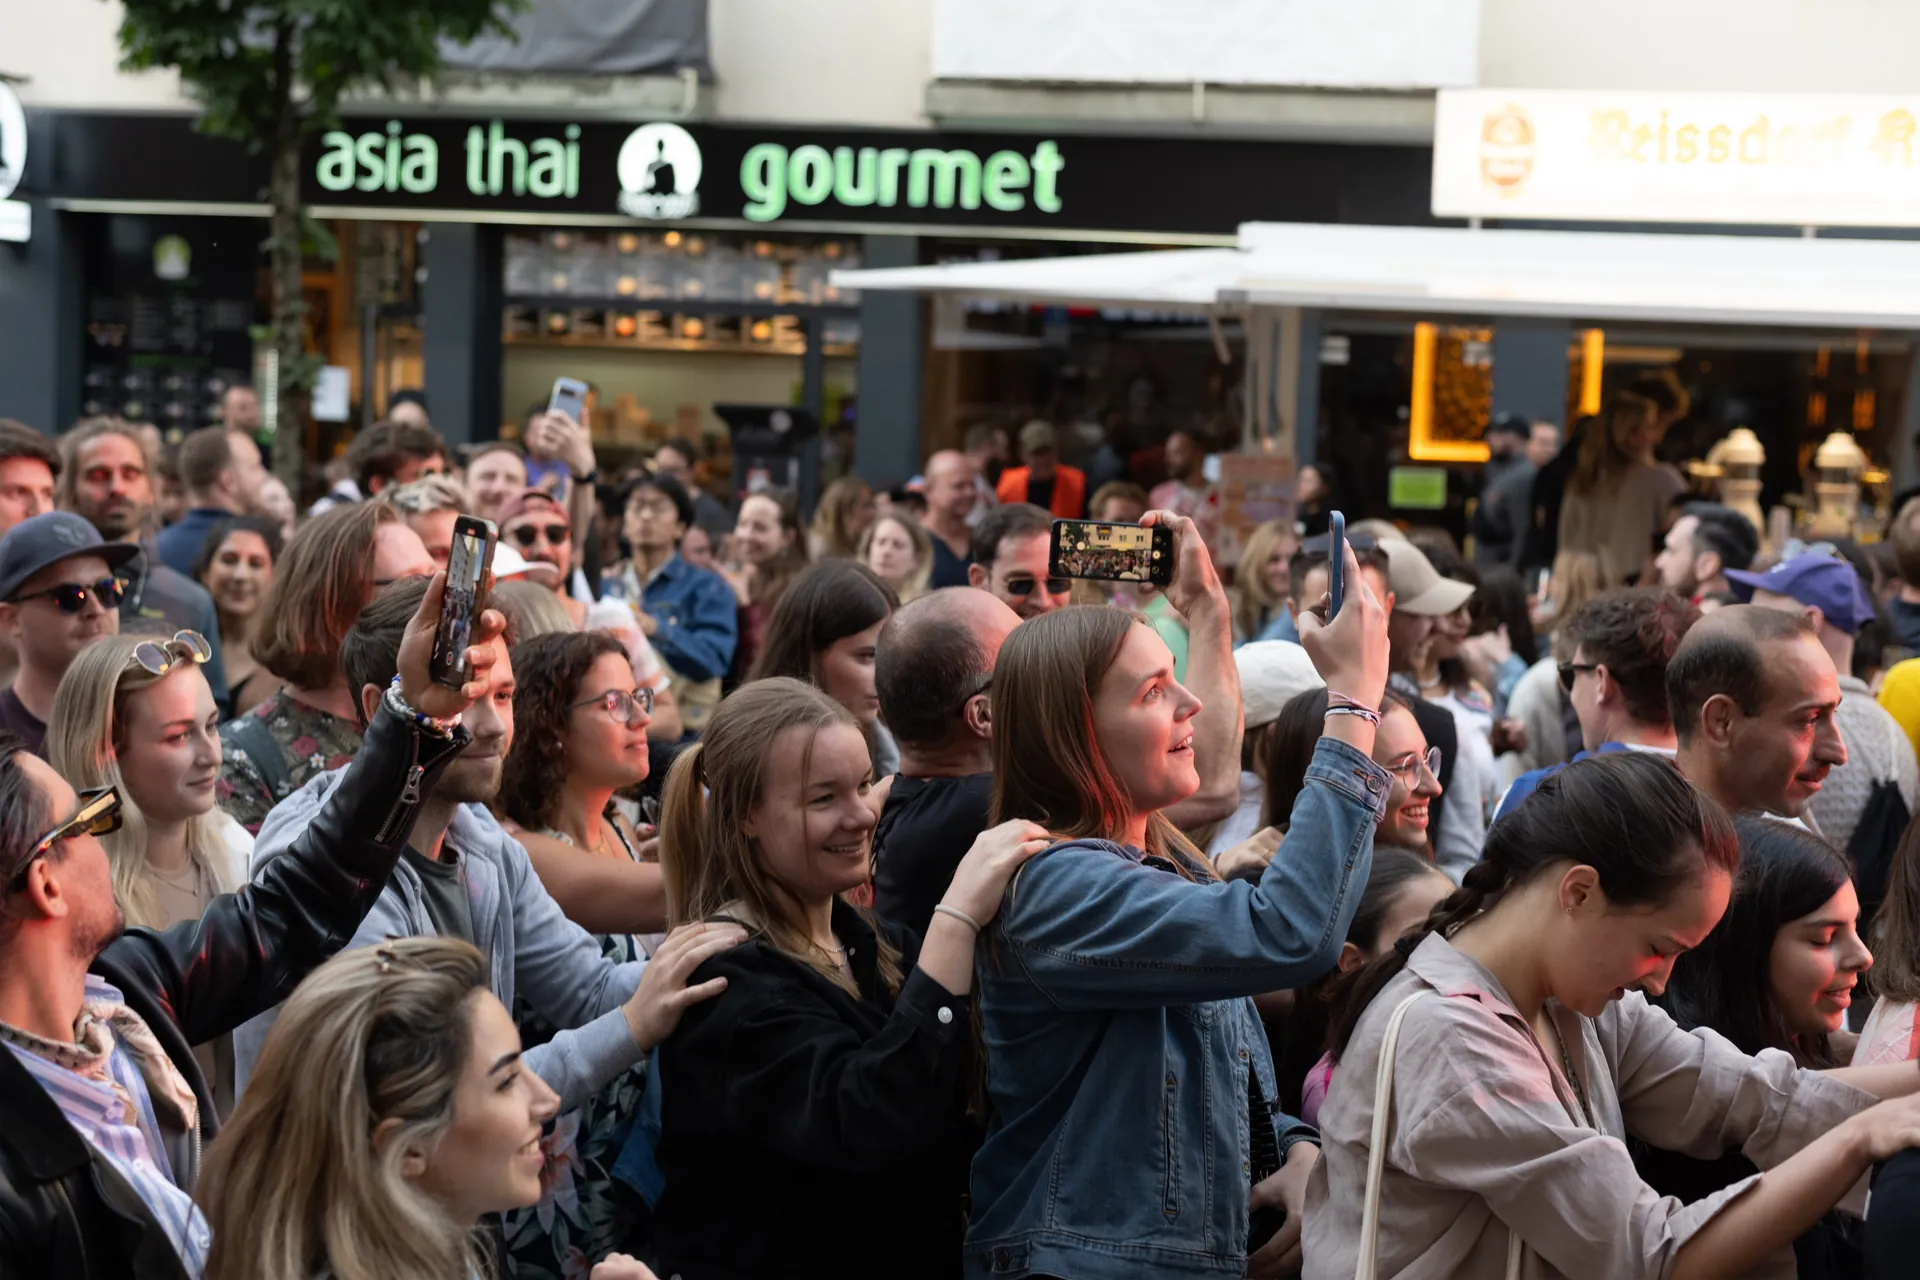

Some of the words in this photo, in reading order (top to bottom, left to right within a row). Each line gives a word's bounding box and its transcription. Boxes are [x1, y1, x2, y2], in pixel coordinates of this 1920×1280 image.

[316, 120, 438, 194] asia
[464, 117, 582, 199] thai
[739, 140, 1065, 222] gourmet
